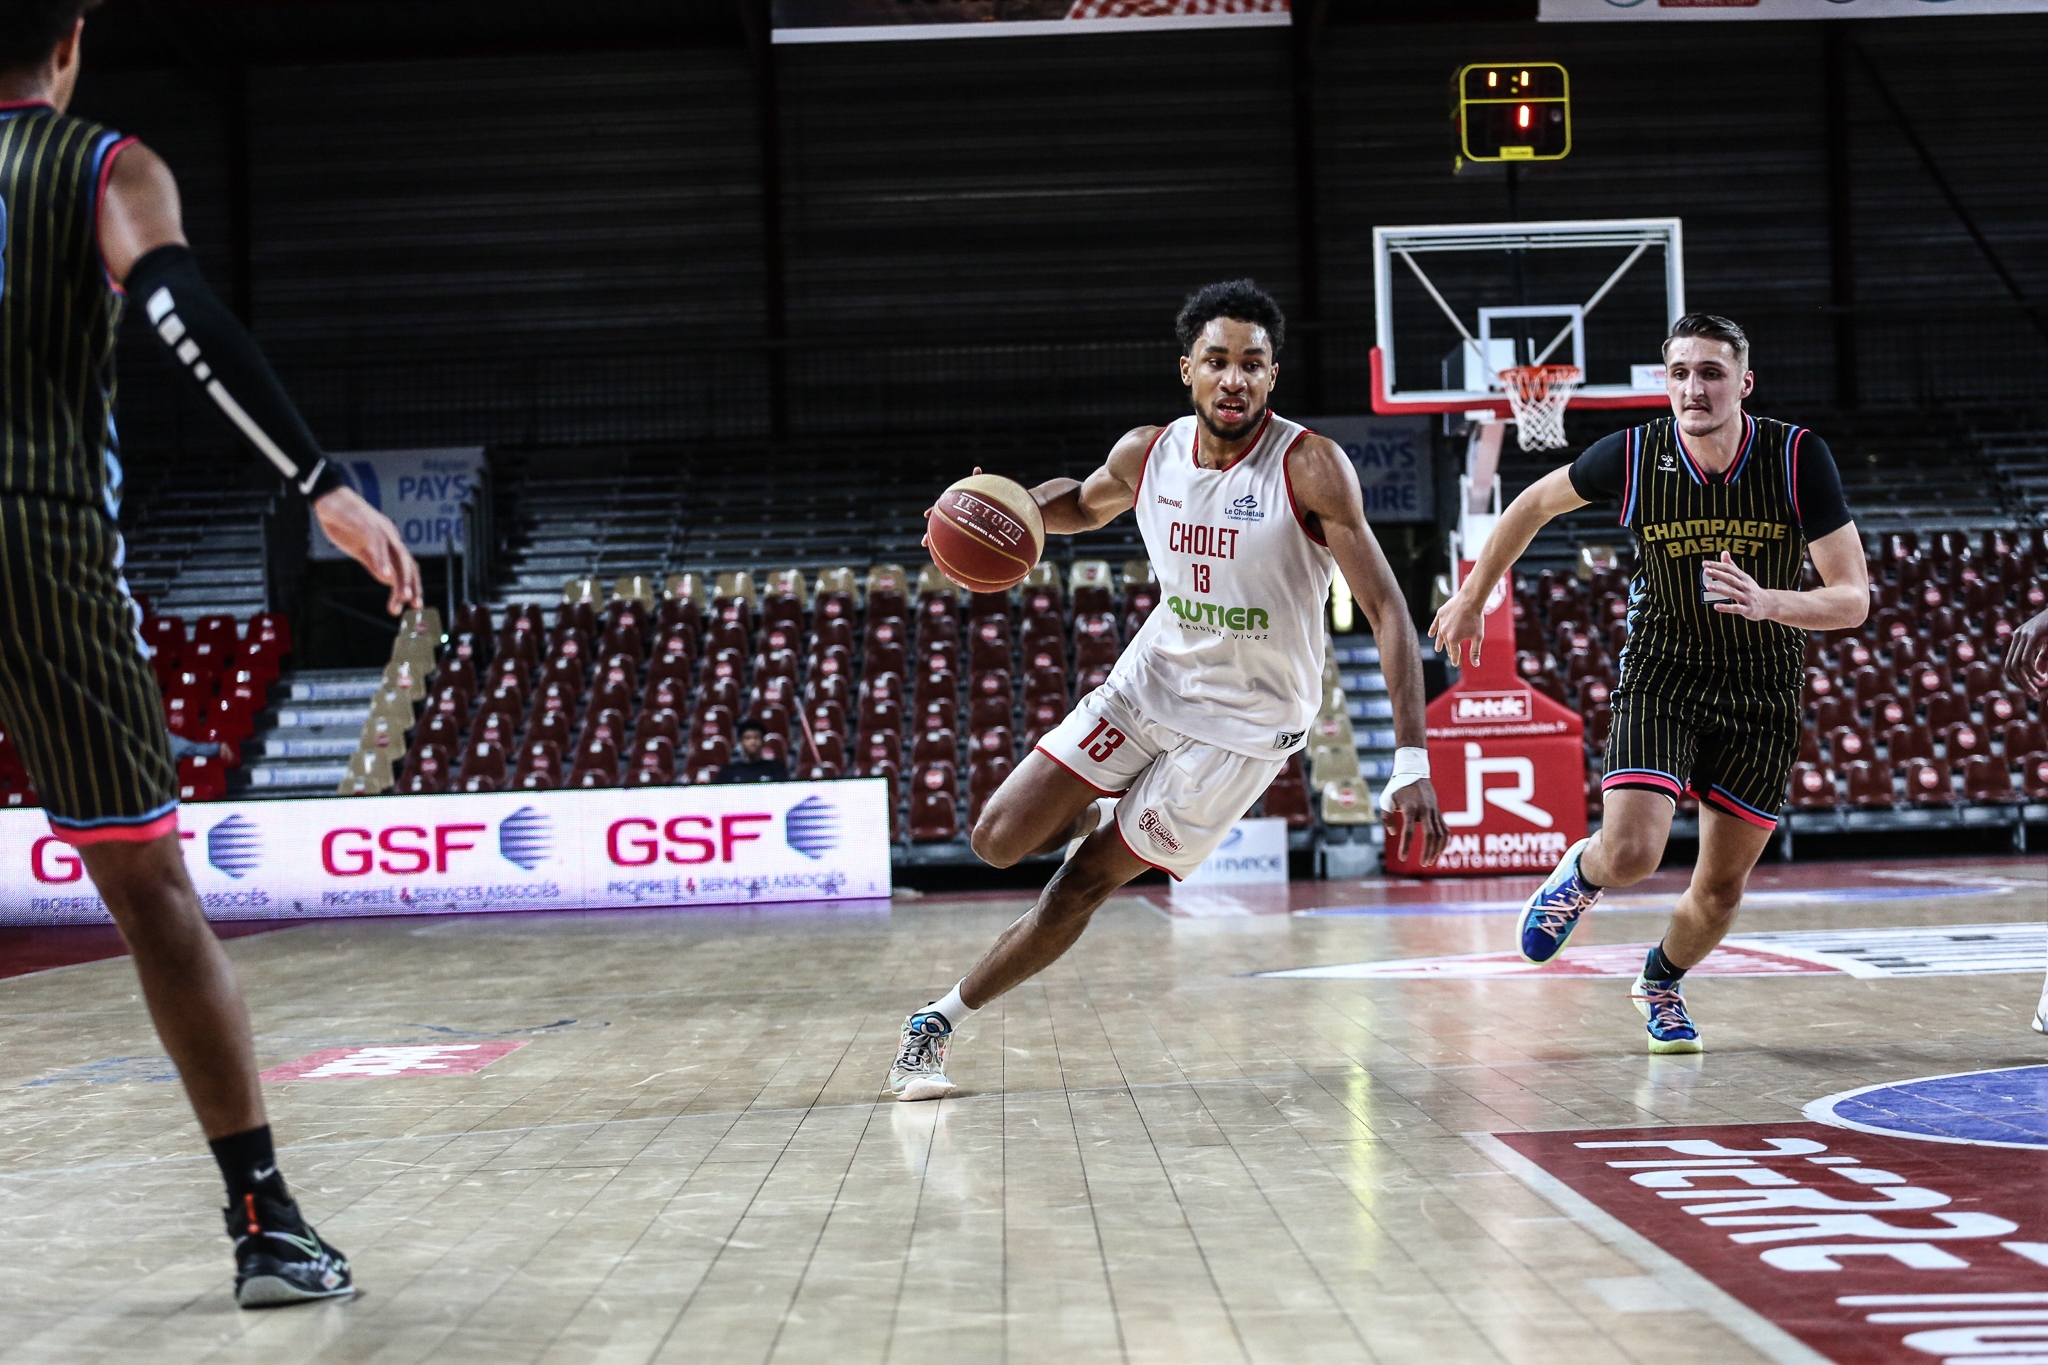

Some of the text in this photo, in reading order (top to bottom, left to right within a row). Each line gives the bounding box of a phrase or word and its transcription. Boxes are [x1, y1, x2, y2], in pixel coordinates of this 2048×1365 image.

[1344, 441, 1416, 468] PAYS
[399, 474, 470, 501] PAYS
[1362, 484, 1416, 510] IRE
[1157, 495, 1182, 508] SPALDING
[1234, 509, 1264, 517] Choletais
[955, 494, 1022, 541] TF-1000
[1643, 518, 1788, 542] CHAMPAGNE
[1169, 522, 1239, 560] CHOLET
[1665, 537, 1766, 559] BASKET
[1191, 563, 1211, 594] 13
[1231, 633, 1268, 641] Vivez
[1077, 716, 1126, 763] 13
[1141, 812, 1156, 830] CB
[321, 823, 487, 877] GSF
[606, 813, 773, 867] GSF
[1484, 832, 1567, 854] ROUYER
[1436, 852, 1560, 869] AUTOMOBILES
